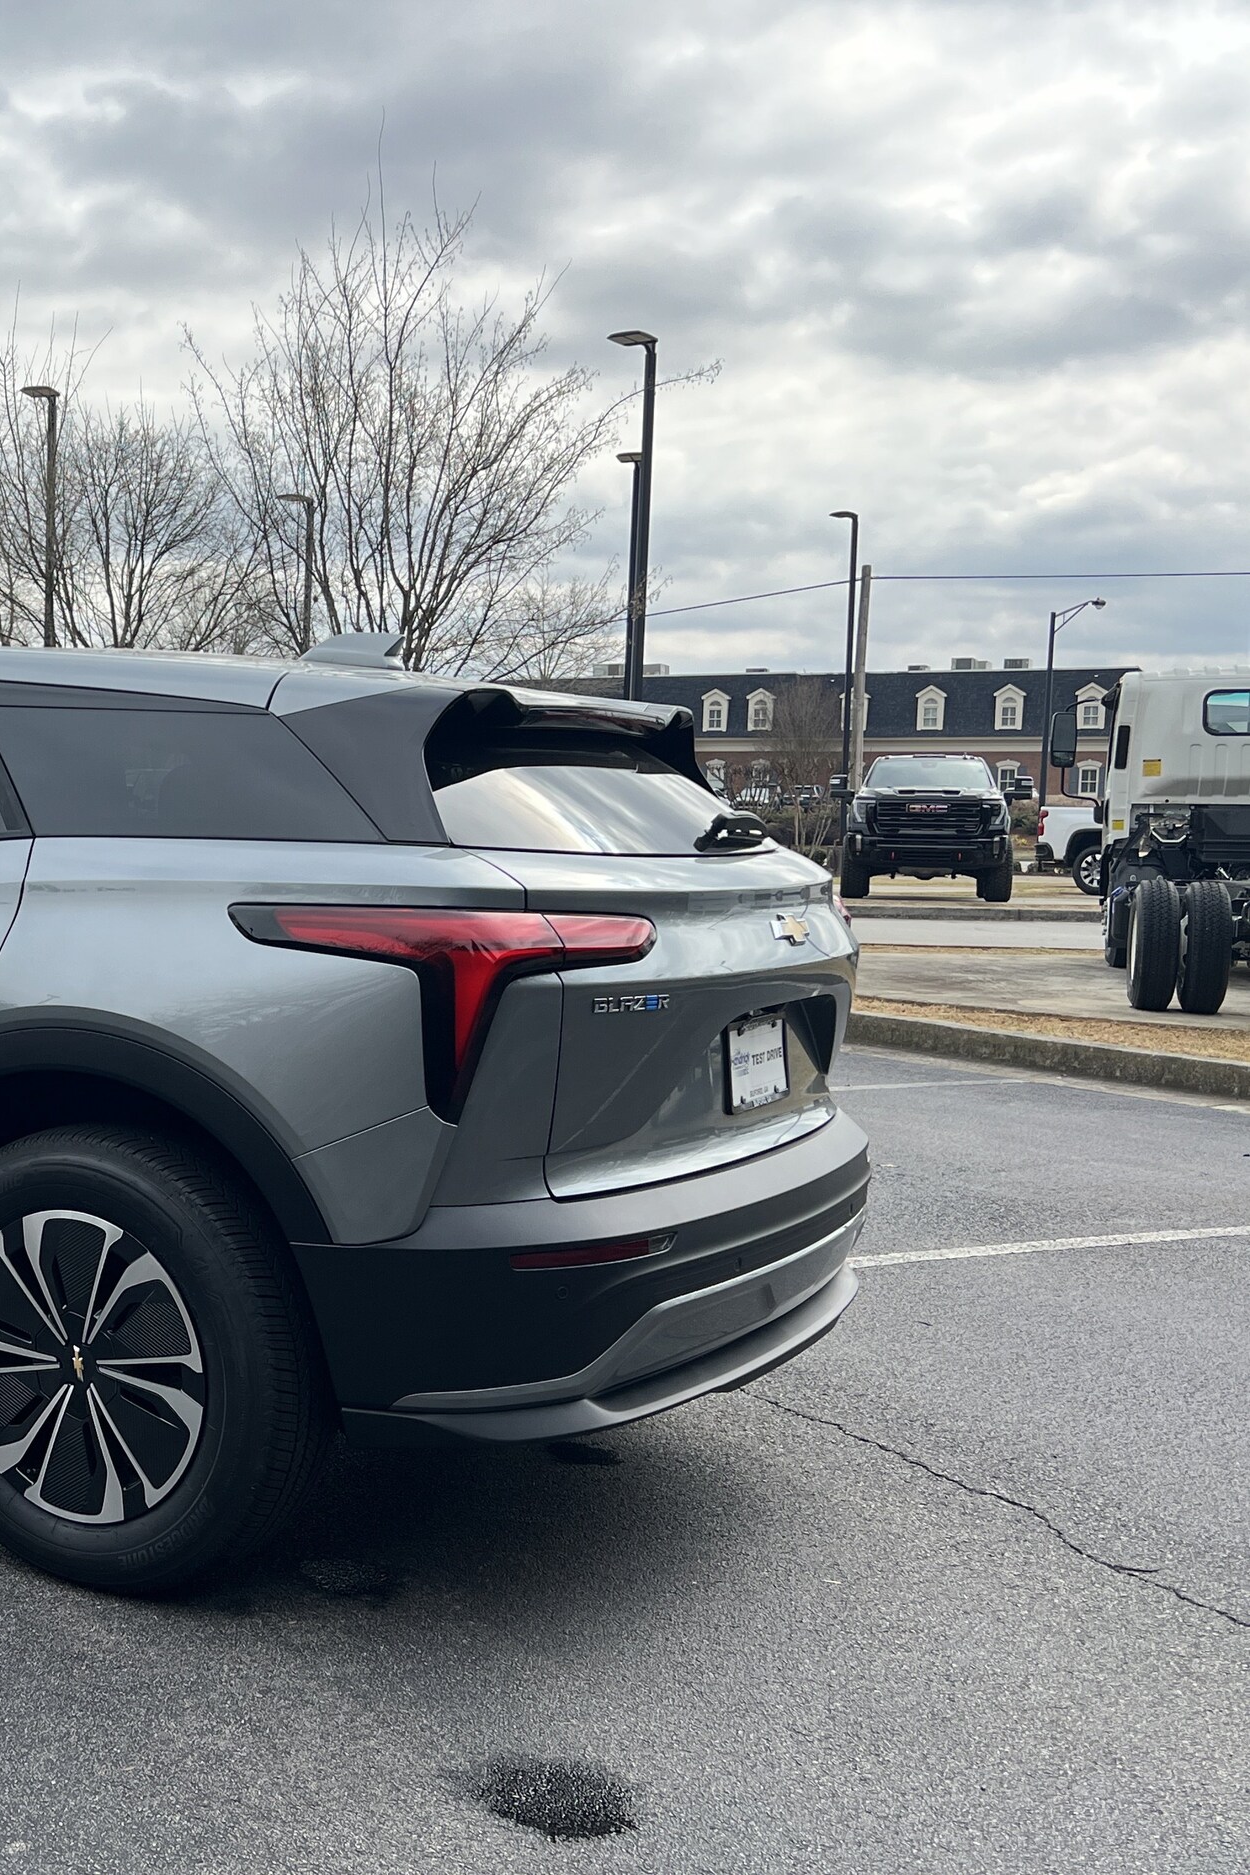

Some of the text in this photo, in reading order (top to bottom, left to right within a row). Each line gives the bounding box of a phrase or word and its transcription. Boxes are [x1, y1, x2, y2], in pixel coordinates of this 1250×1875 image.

[908, 803, 949, 813] GMC
[593, 993, 670, 1014] BLAZER
[752, 1051, 765, 1066] TEST
[767, 1047, 782, 1061] DRIVE
[117, 1494, 216, 1569] BRIDGESTONE
